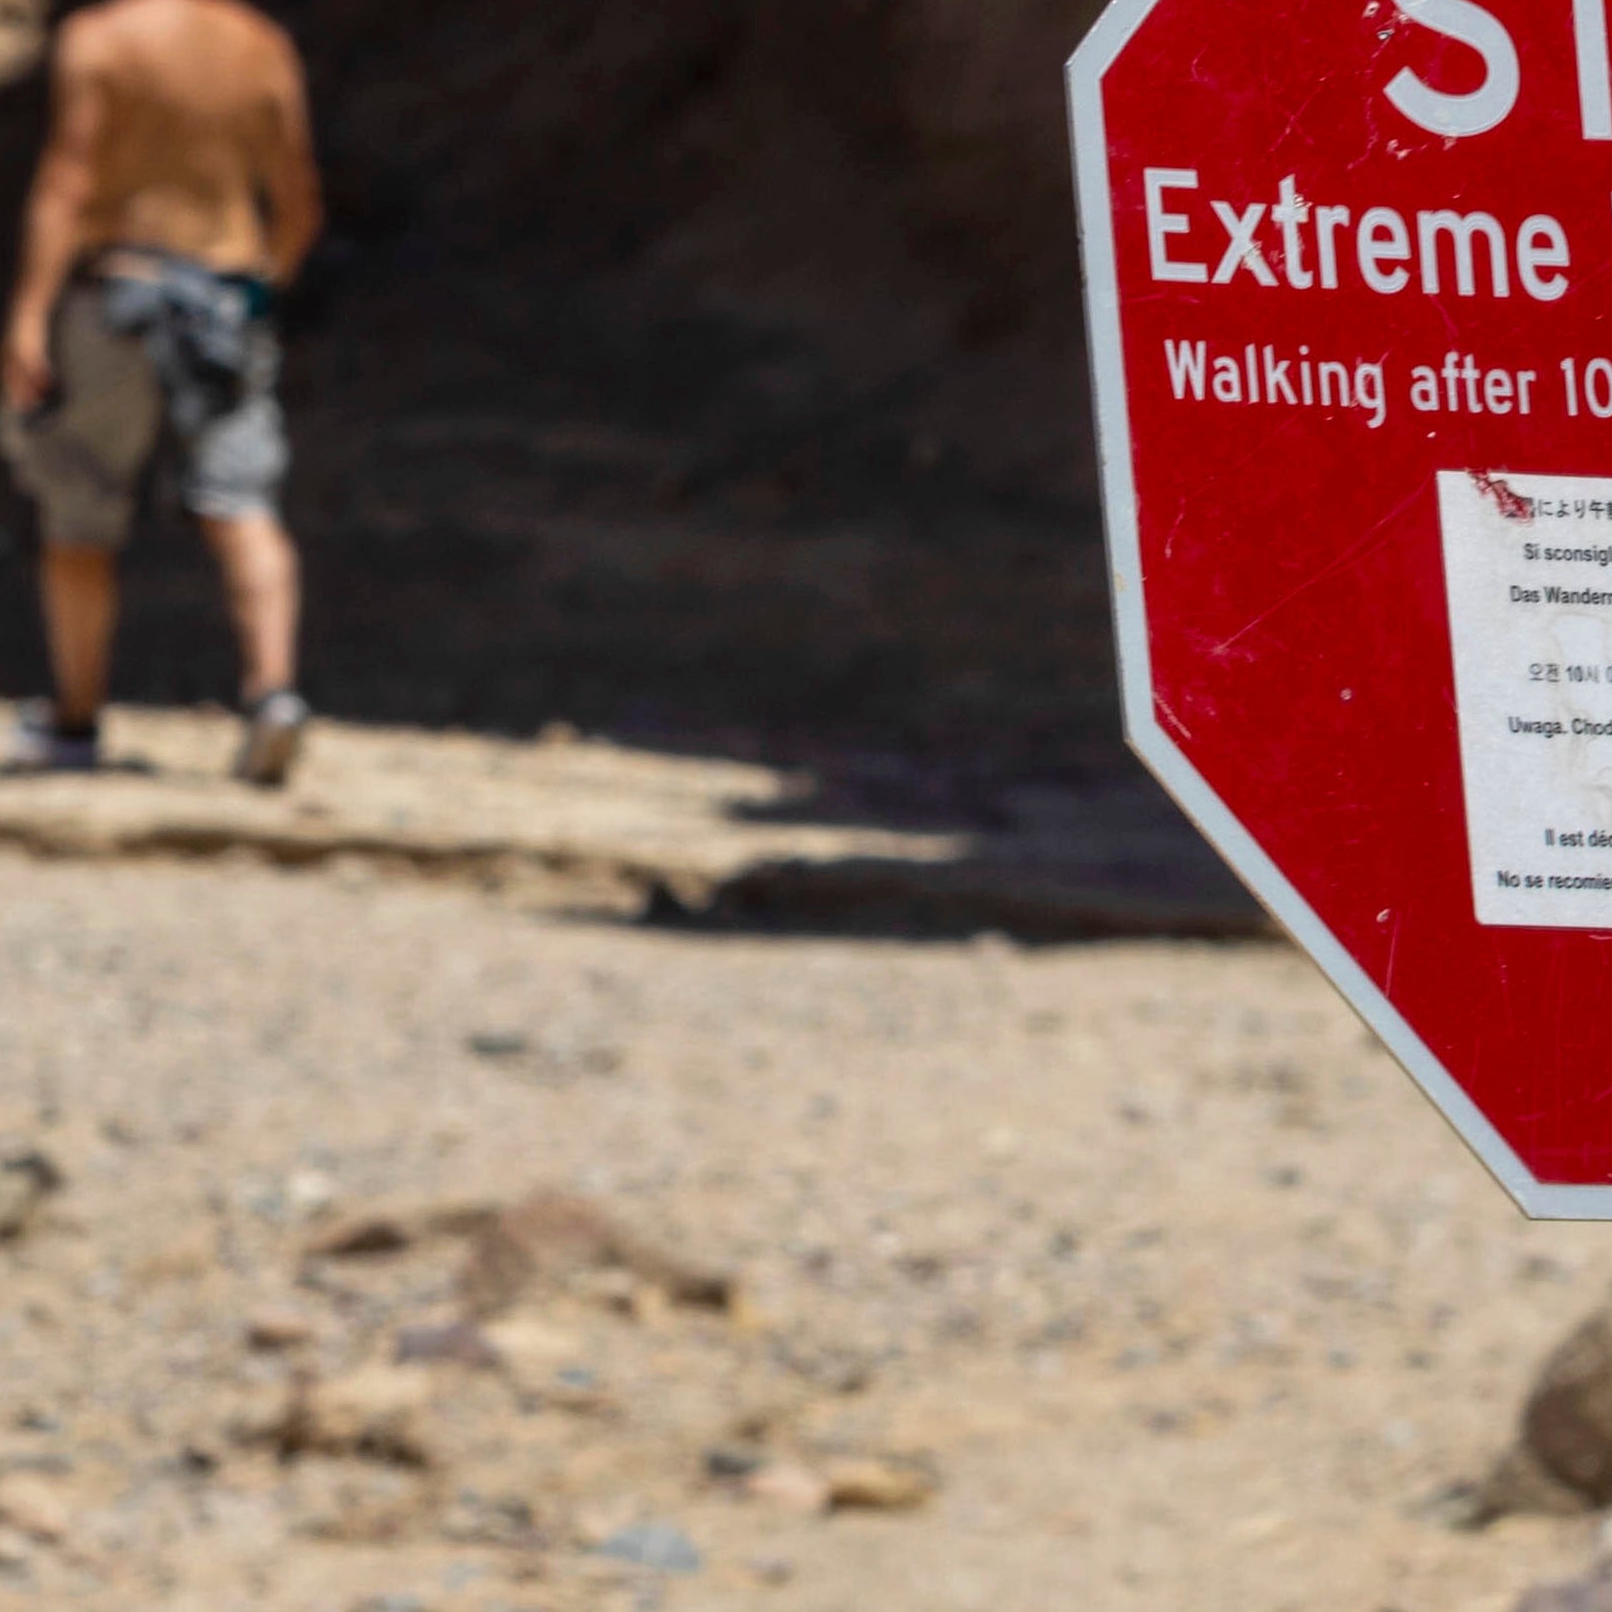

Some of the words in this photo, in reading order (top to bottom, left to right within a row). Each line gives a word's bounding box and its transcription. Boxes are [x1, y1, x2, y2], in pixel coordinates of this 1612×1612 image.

[1143, 167, 1570, 302] Extreme
[1163, 338, 1385, 429] Walking
[1409, 351, 1535, 418] after
[1524, 543, 1539, 560] Si
[1509, 585, 1539, 603] Das
[1528, 662, 1560, 683] 오전
[1508, 716, 1567, 738] Uwaga.
[1544, 828, 1555, 846] Il
[1558, 831, 1584, 848] est
[1497, 870, 1520, 888] No
[1524, 874, 1544, 889] se
